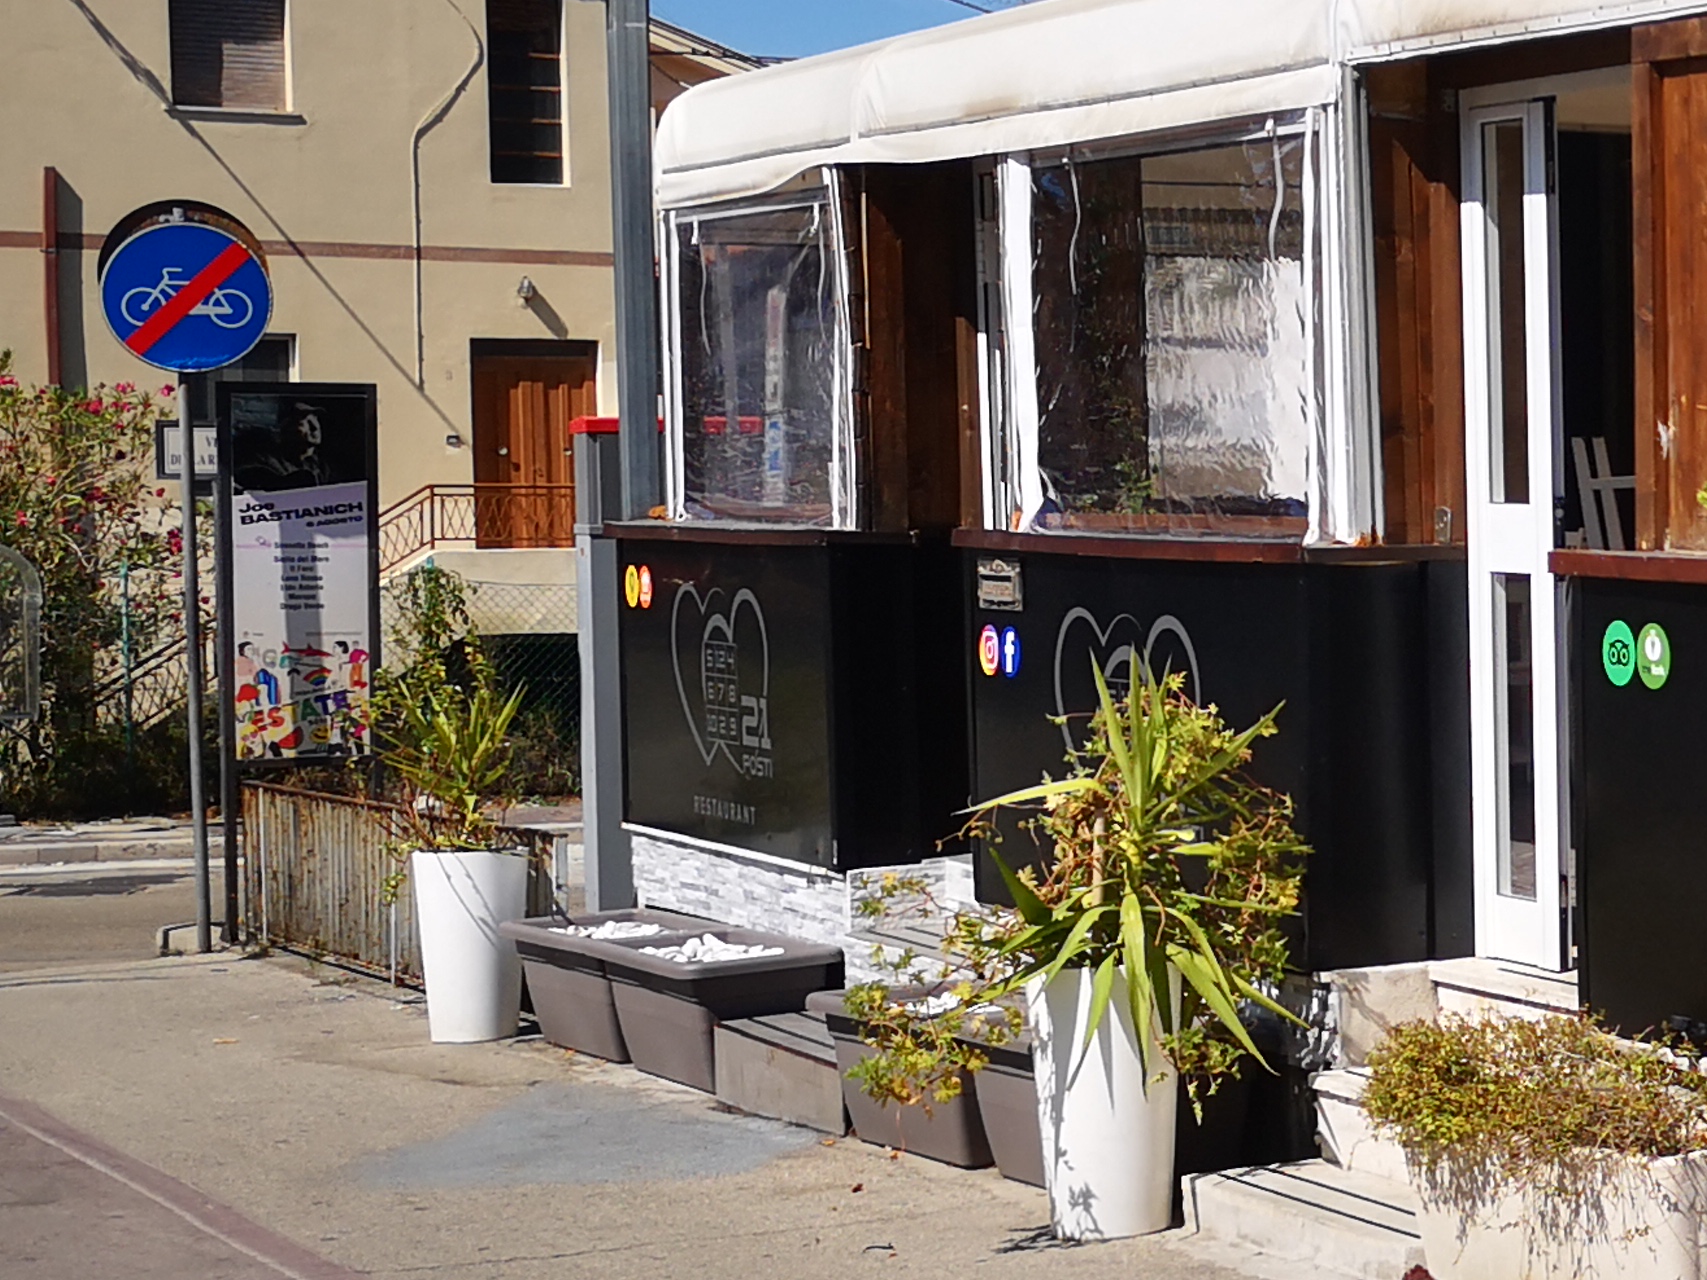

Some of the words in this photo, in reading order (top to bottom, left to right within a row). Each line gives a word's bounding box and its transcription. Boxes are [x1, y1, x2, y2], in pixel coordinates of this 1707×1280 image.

[240, 500, 363, 525] BASTIANICH
[740, 695, 773, 751] 21
[741, 754, 773, 779] POSTI
[693, 795, 756, 825] RESTAURANT
